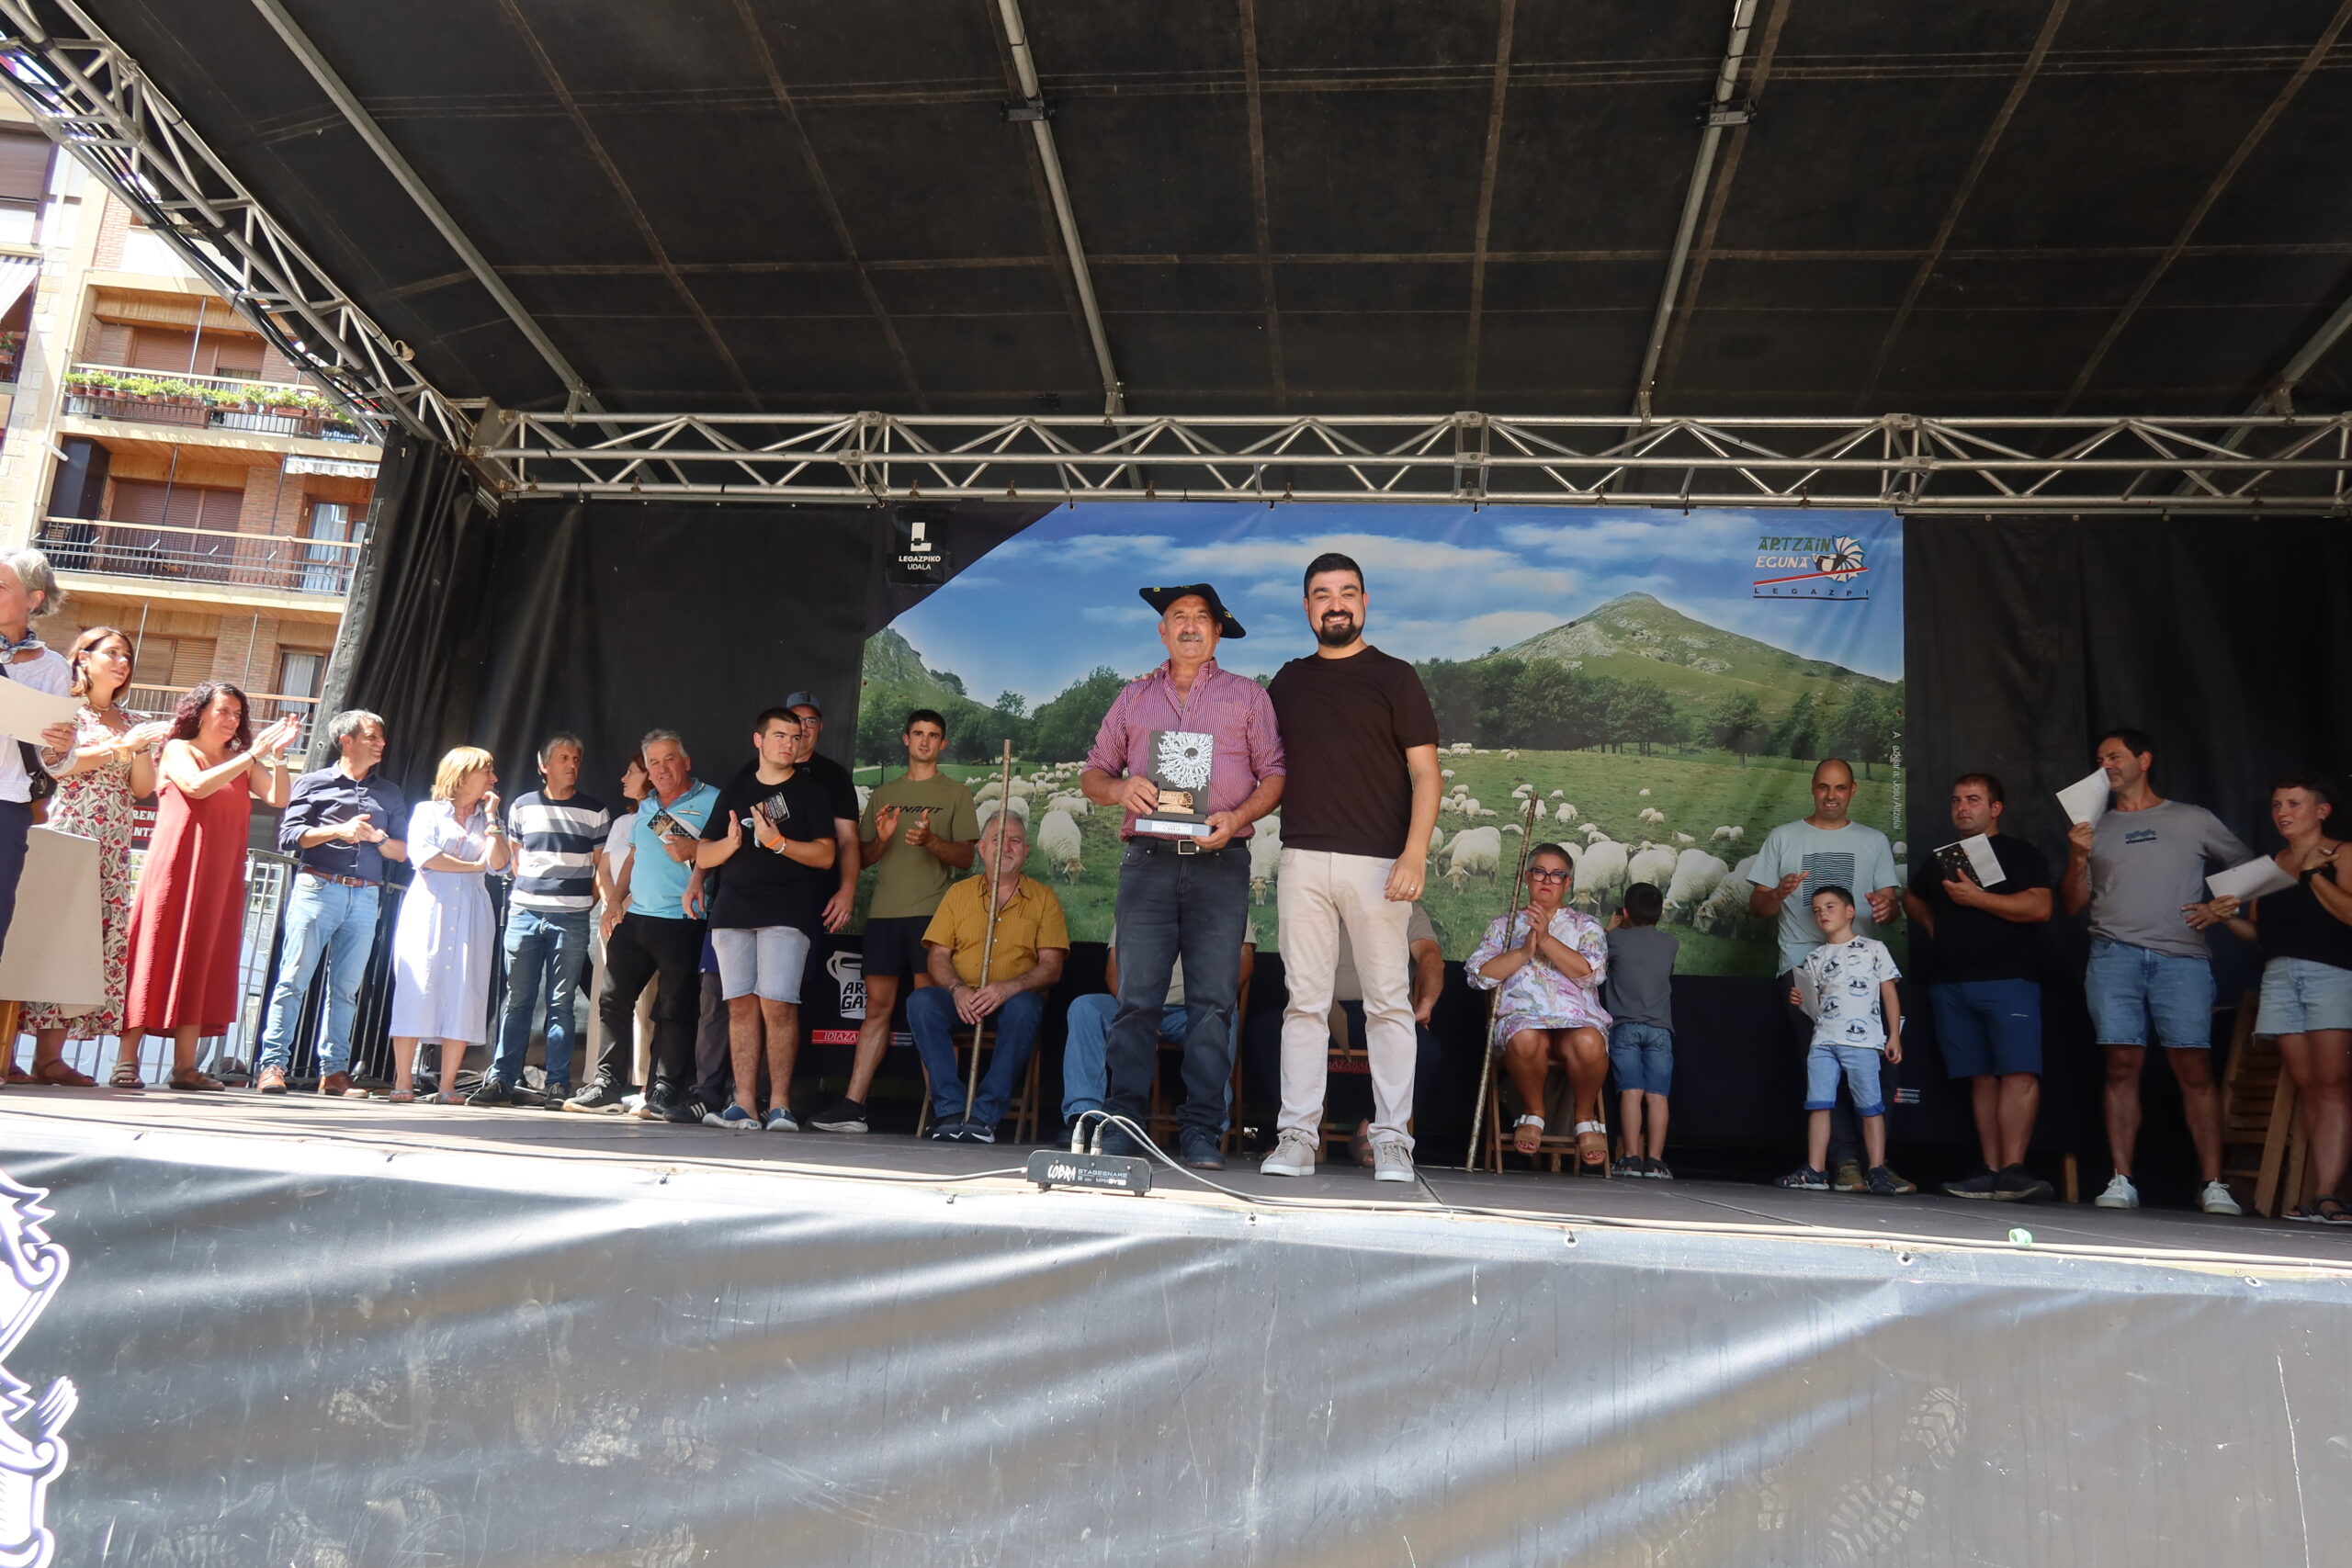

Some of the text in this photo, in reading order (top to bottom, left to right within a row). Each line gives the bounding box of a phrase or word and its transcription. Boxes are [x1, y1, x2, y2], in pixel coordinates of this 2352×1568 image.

[1755, 556, 1811, 569] EGUNA
[1754, 588, 1869, 596] LEGAZPI
[1893, 780, 1901, 800] Josu
[842, 981, 867, 995] AR
[842, 995, 867, 1010] GA
[823, 1032, 860, 1041] IDIAZA
[1047, 1164, 1077, 1182] COBRA
[1078, 1168, 1128, 1179] STAGESNAKE
